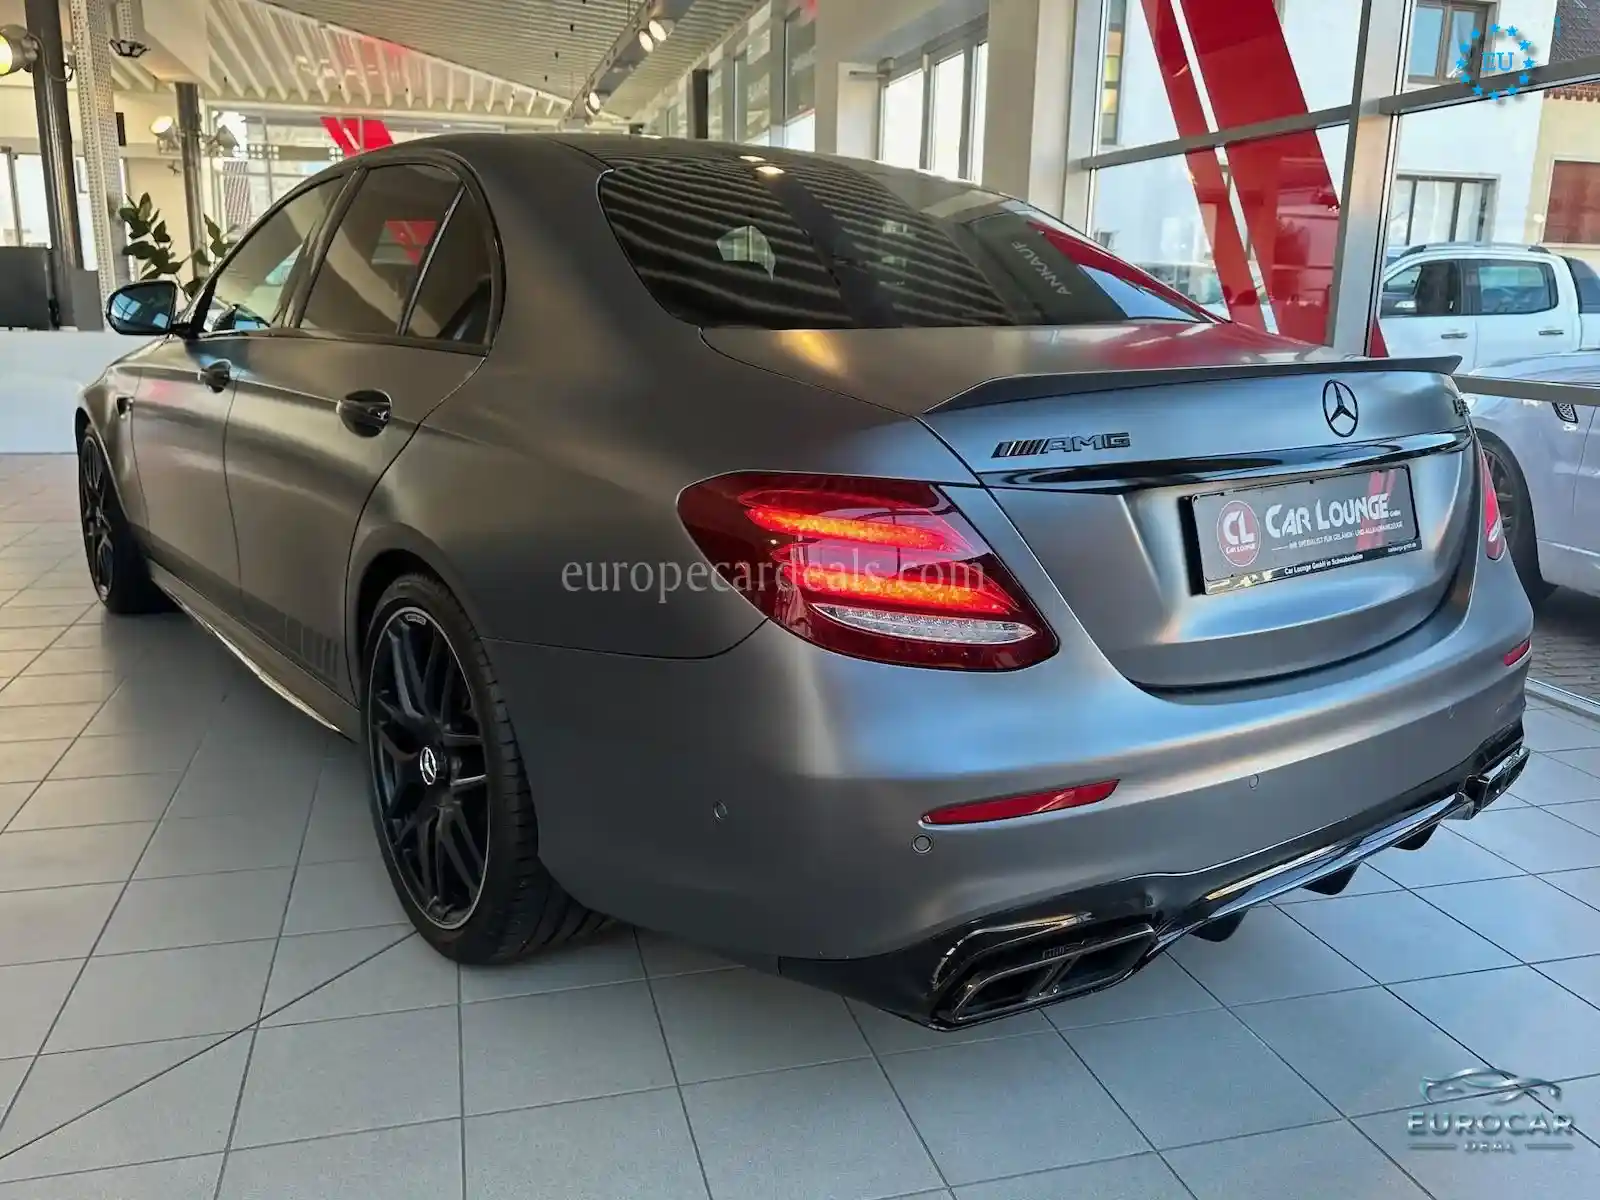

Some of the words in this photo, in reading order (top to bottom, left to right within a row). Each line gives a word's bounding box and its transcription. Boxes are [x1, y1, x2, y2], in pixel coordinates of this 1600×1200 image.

[1011, 240, 1073, 295] ANKAUF
[1036, 432, 1131, 455] AMG
[1223, 510, 1255, 546] CL
[1315, 492, 1390, 531] LOUNGE
